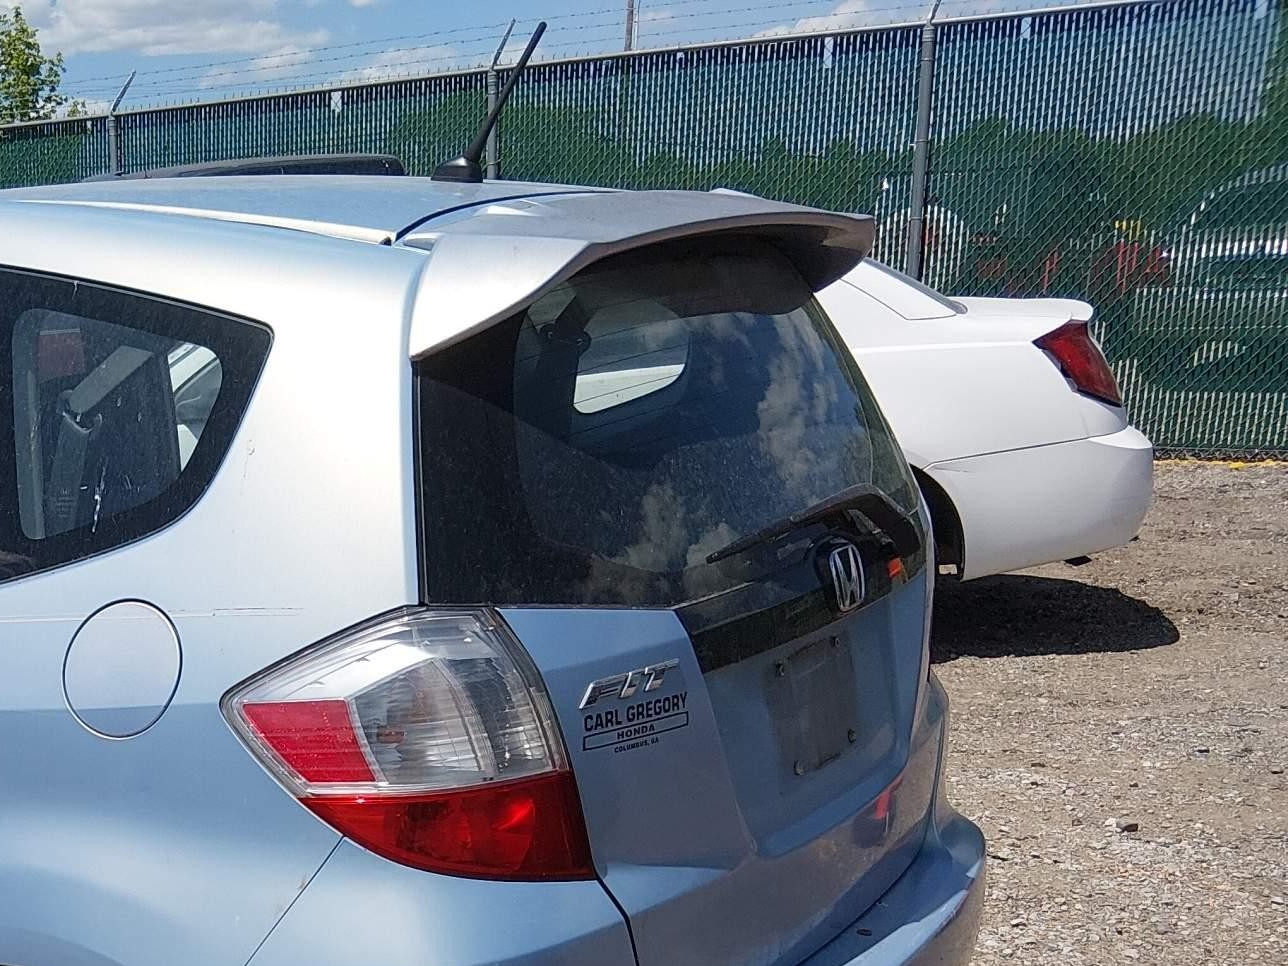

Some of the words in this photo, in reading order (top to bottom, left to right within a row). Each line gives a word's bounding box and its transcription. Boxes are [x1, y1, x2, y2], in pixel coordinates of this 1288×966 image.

[584, 709, 622, 732] CARL
[626, 692, 688, 723] GREGORY
[617, 724, 656, 740] HONDA
